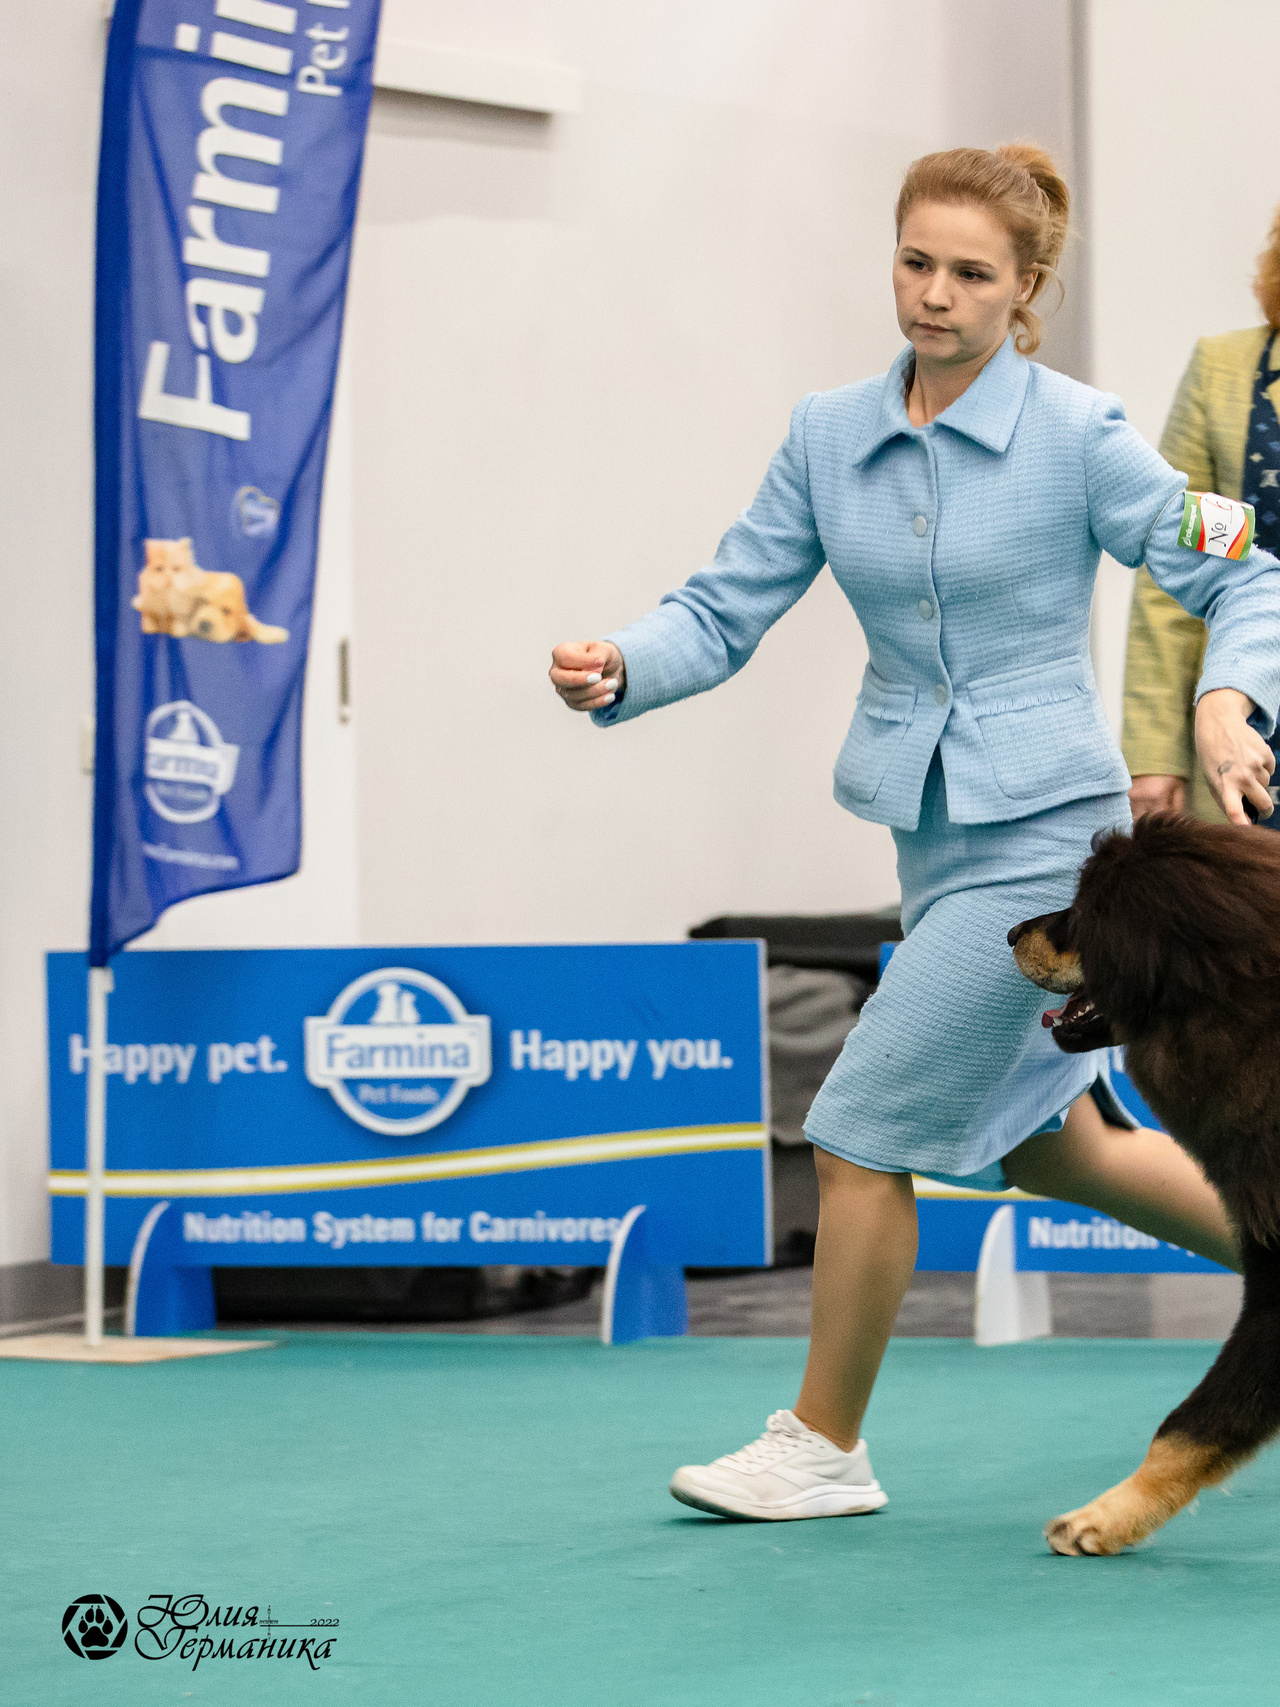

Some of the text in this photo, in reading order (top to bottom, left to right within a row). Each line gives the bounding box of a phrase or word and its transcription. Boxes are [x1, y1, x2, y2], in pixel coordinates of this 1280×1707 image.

[296, 21, 350, 97] Pet
[208, 1034, 288, 1084] pet.
[326, 1032, 470, 1069] Farmina
[511, 1030, 733, 1080] Happy you.
[184, 1211, 306, 1243] Nutrition
[313, 1211, 416, 1248] System
[422, 1211, 463, 1243] for
